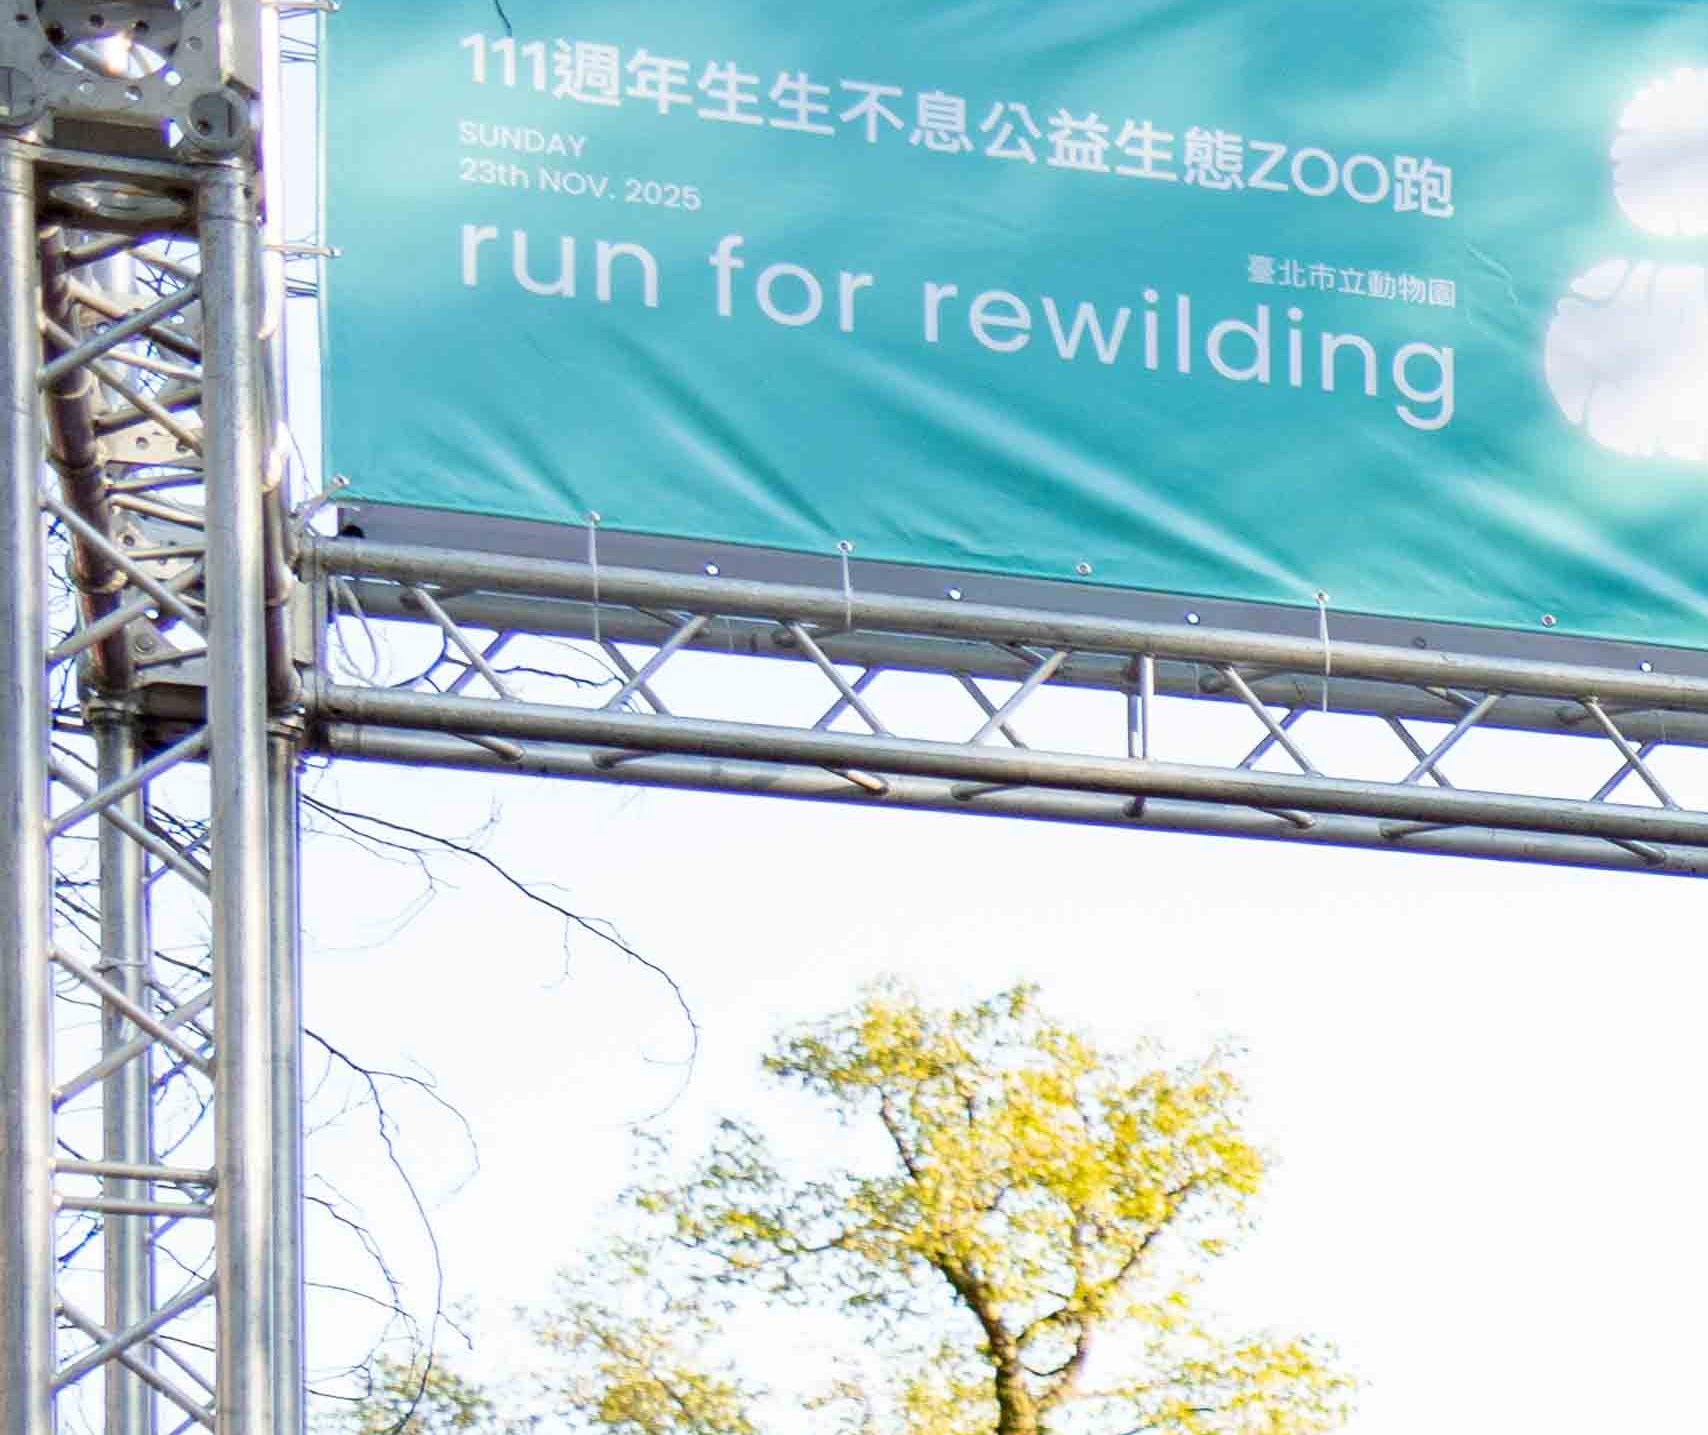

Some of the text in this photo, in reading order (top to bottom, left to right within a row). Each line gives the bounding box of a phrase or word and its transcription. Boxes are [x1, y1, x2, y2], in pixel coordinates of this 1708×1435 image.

[457, 120, 586, 158] SUNDAY
[460, 33, 1455, 219] 111週年生生不息公益生態ZOO跑
[459, 157, 702, 212] 23th NOV. 2025
[1248, 253, 1457, 309] 臺北市立動物園
[461, 222, 1456, 431] run for rewilding
